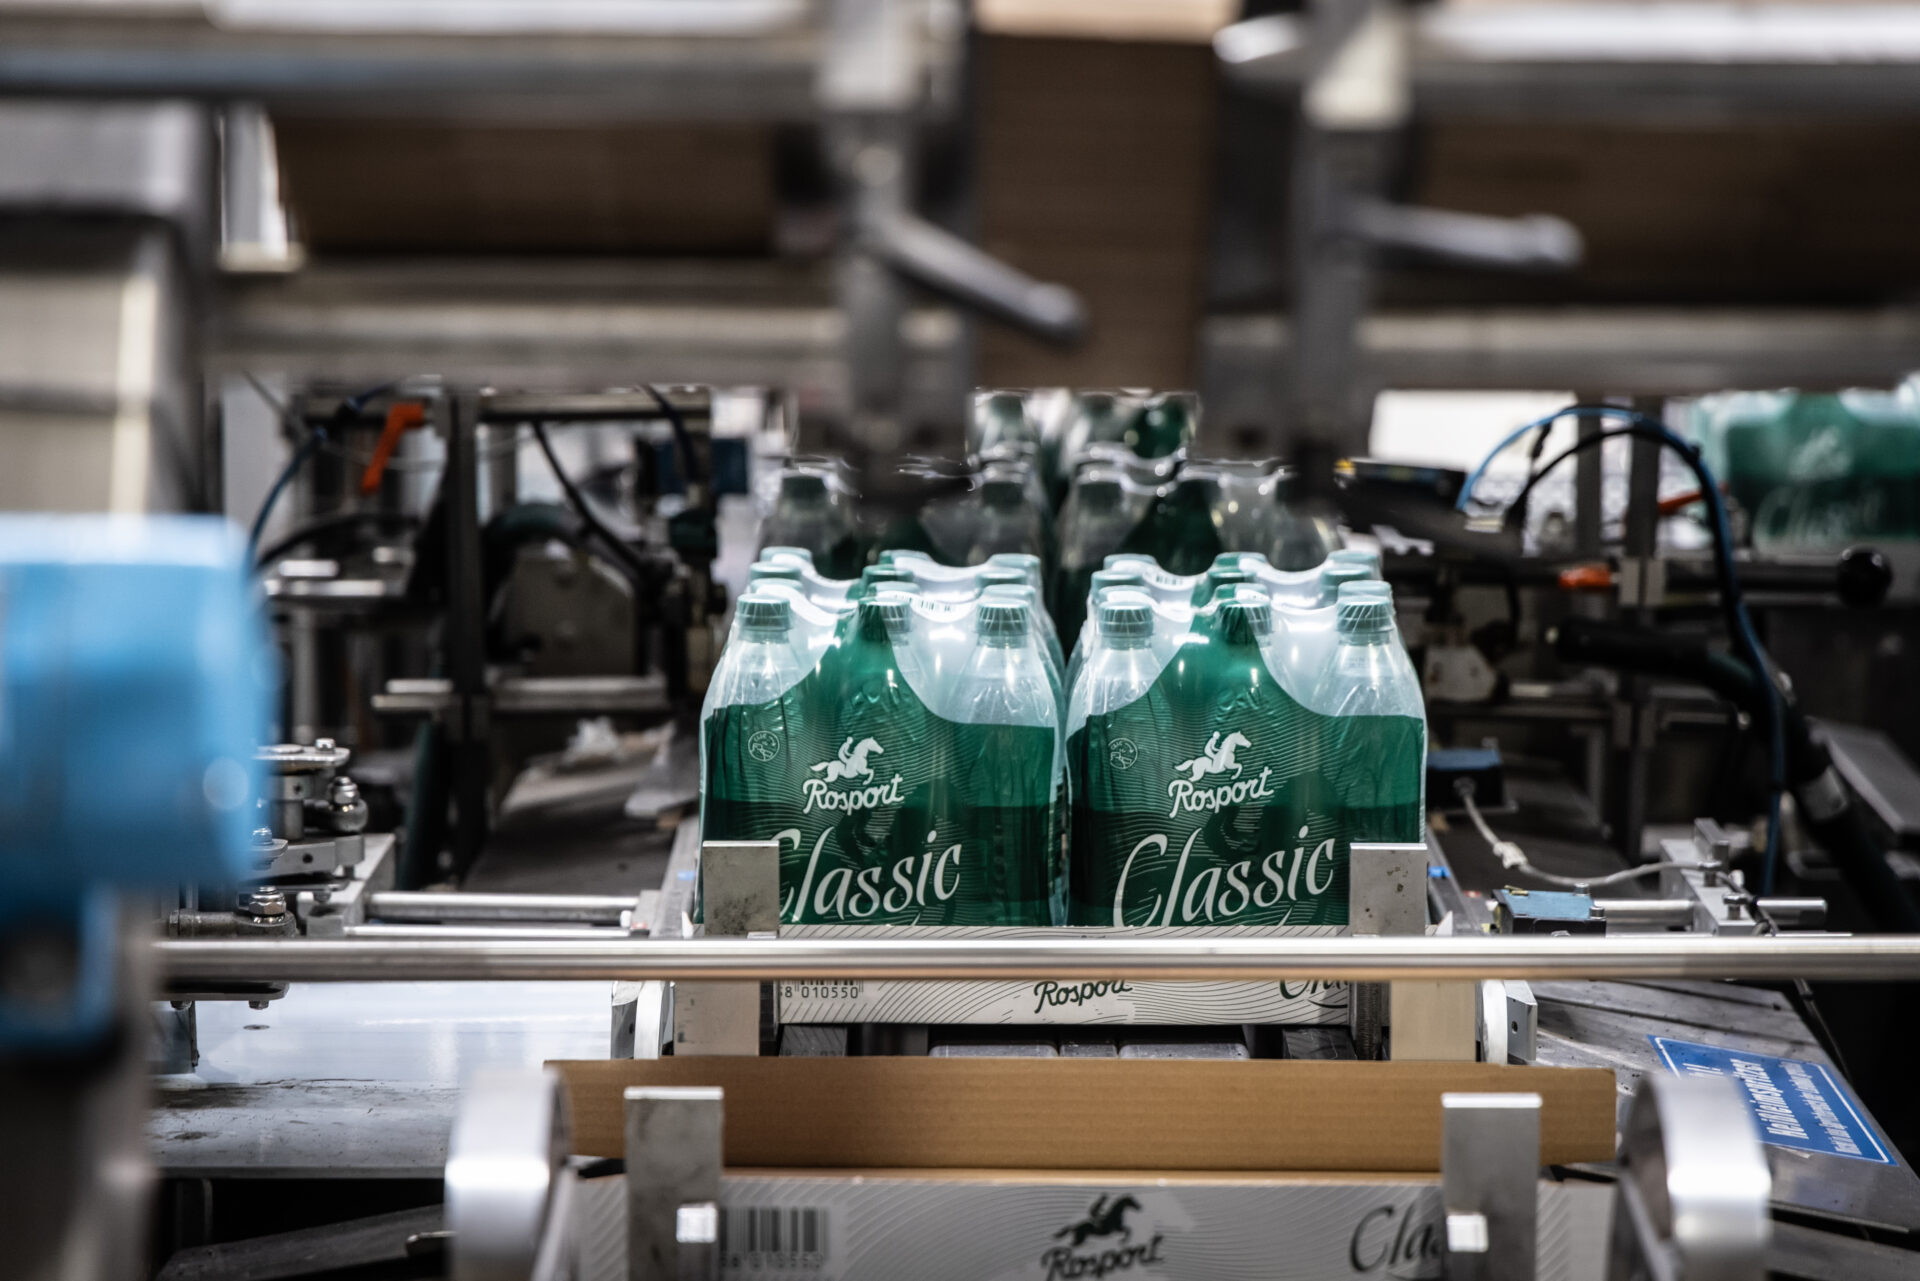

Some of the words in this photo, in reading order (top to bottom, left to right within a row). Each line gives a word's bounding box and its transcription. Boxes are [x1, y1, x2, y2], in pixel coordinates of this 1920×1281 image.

[803, 773, 904, 815] Rosport
[1168, 766, 1275, 818] Rosport
[1113, 825, 1336, 926] Classic
[801, 986, 858, 999] 010550
[1040, 1232, 1164, 1281] Rosport
